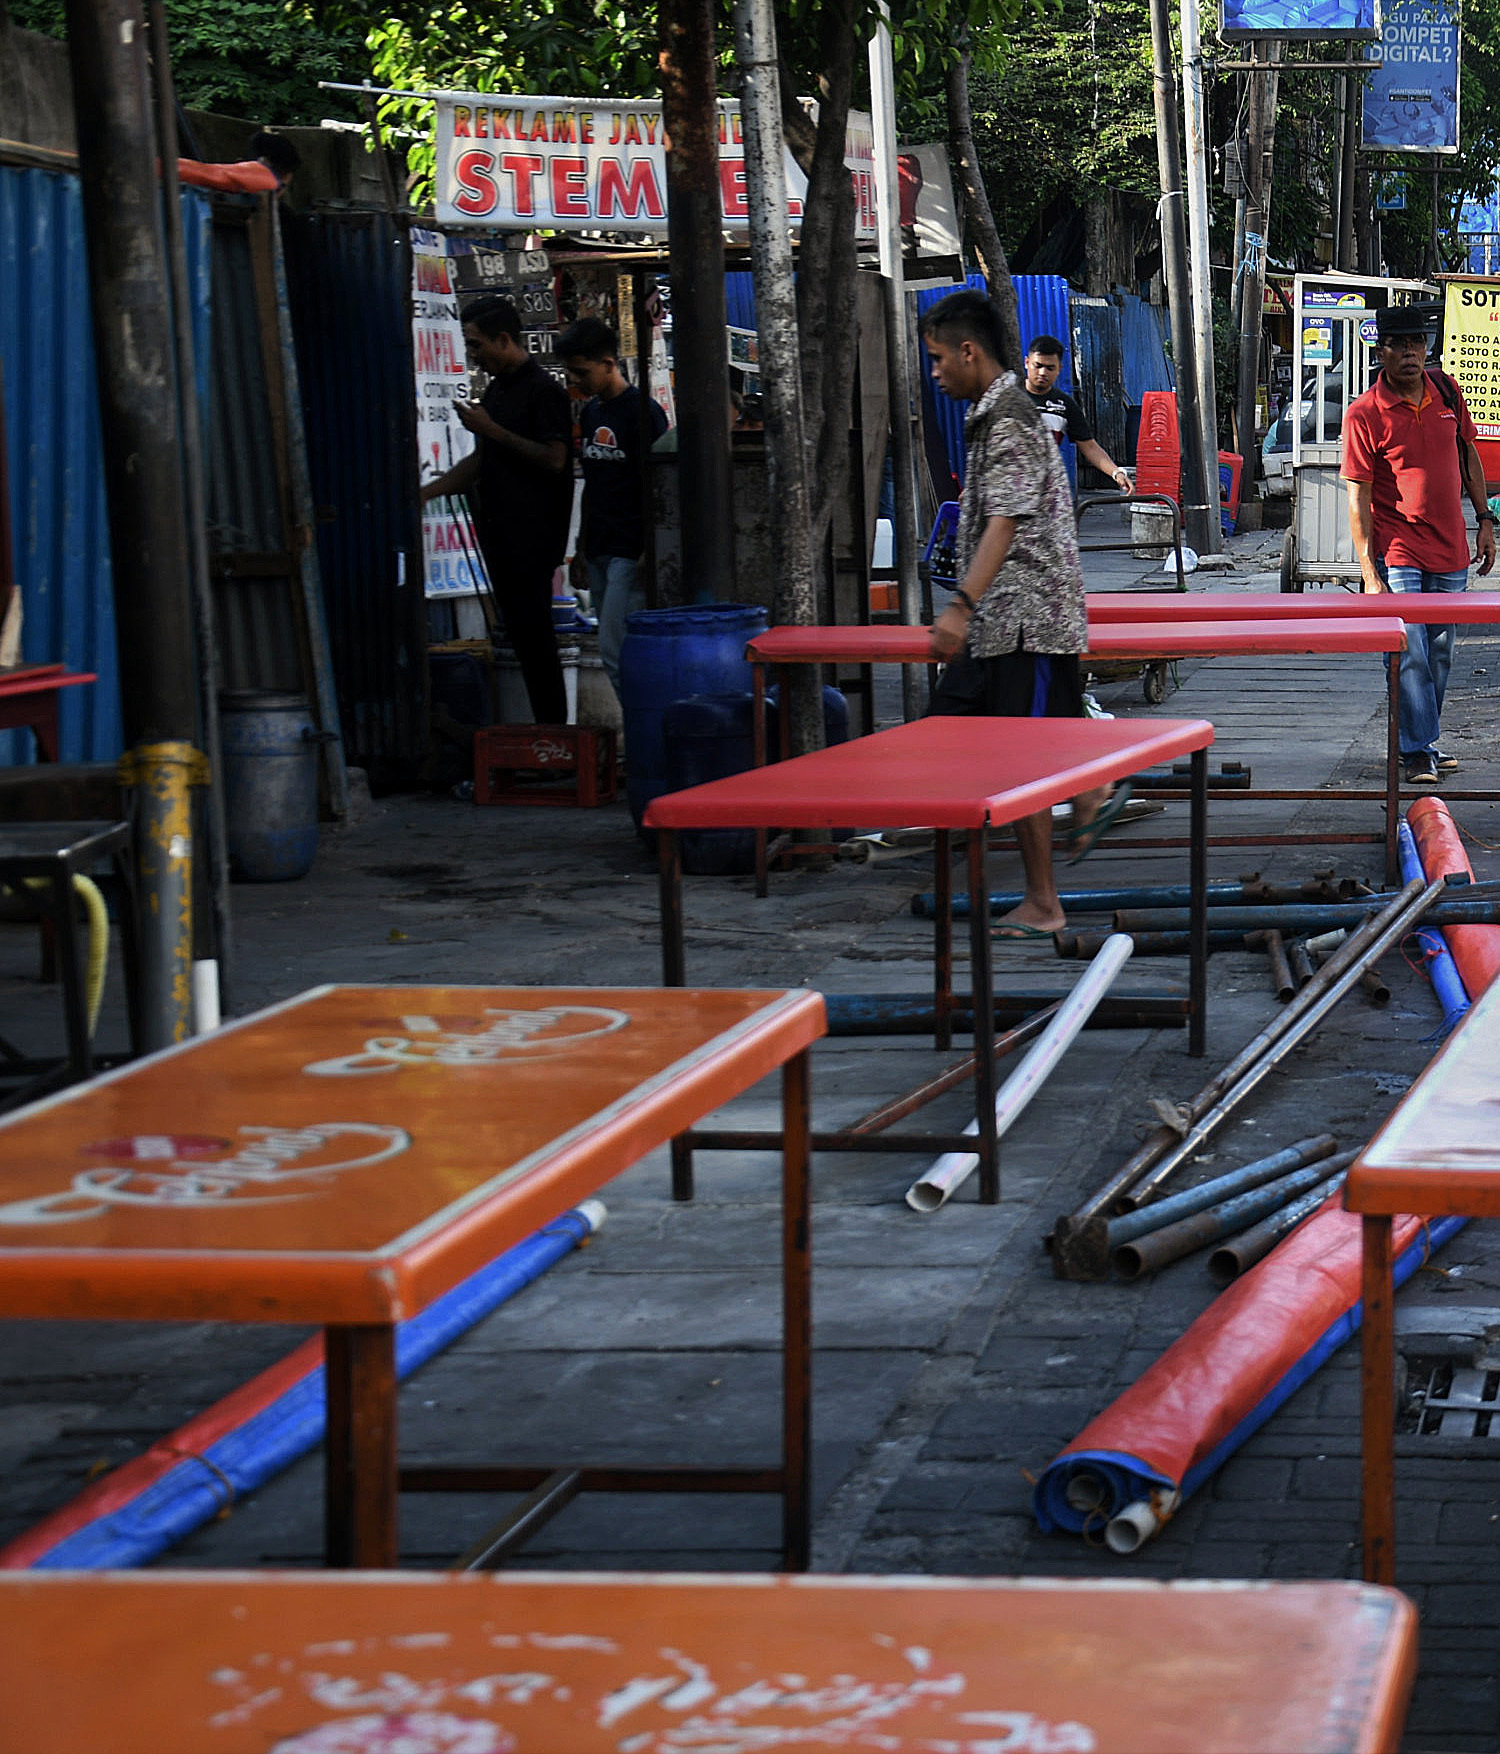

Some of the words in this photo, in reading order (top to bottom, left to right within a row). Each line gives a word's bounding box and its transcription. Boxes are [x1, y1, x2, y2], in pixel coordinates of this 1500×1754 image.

[1384, 26, 1452, 43] OMPET
[1369, 45, 1452, 63] DIGITAL?
[454, 105, 594, 144] REKLAME
[609, 112, 667, 145] JAY
[474, 255, 506, 277] 198
[518, 250, 549, 274] ASD
[1461, 335, 1490, 344] SOTO
[1460, 347, 1489, 356] SOTO
[1460, 360, 1488, 369] SOTO
[1459, 372, 1488, 382] SOTO
[1460, 386, 1487, 395] SOTO
[1465, 398, 1486, 407] OTO
